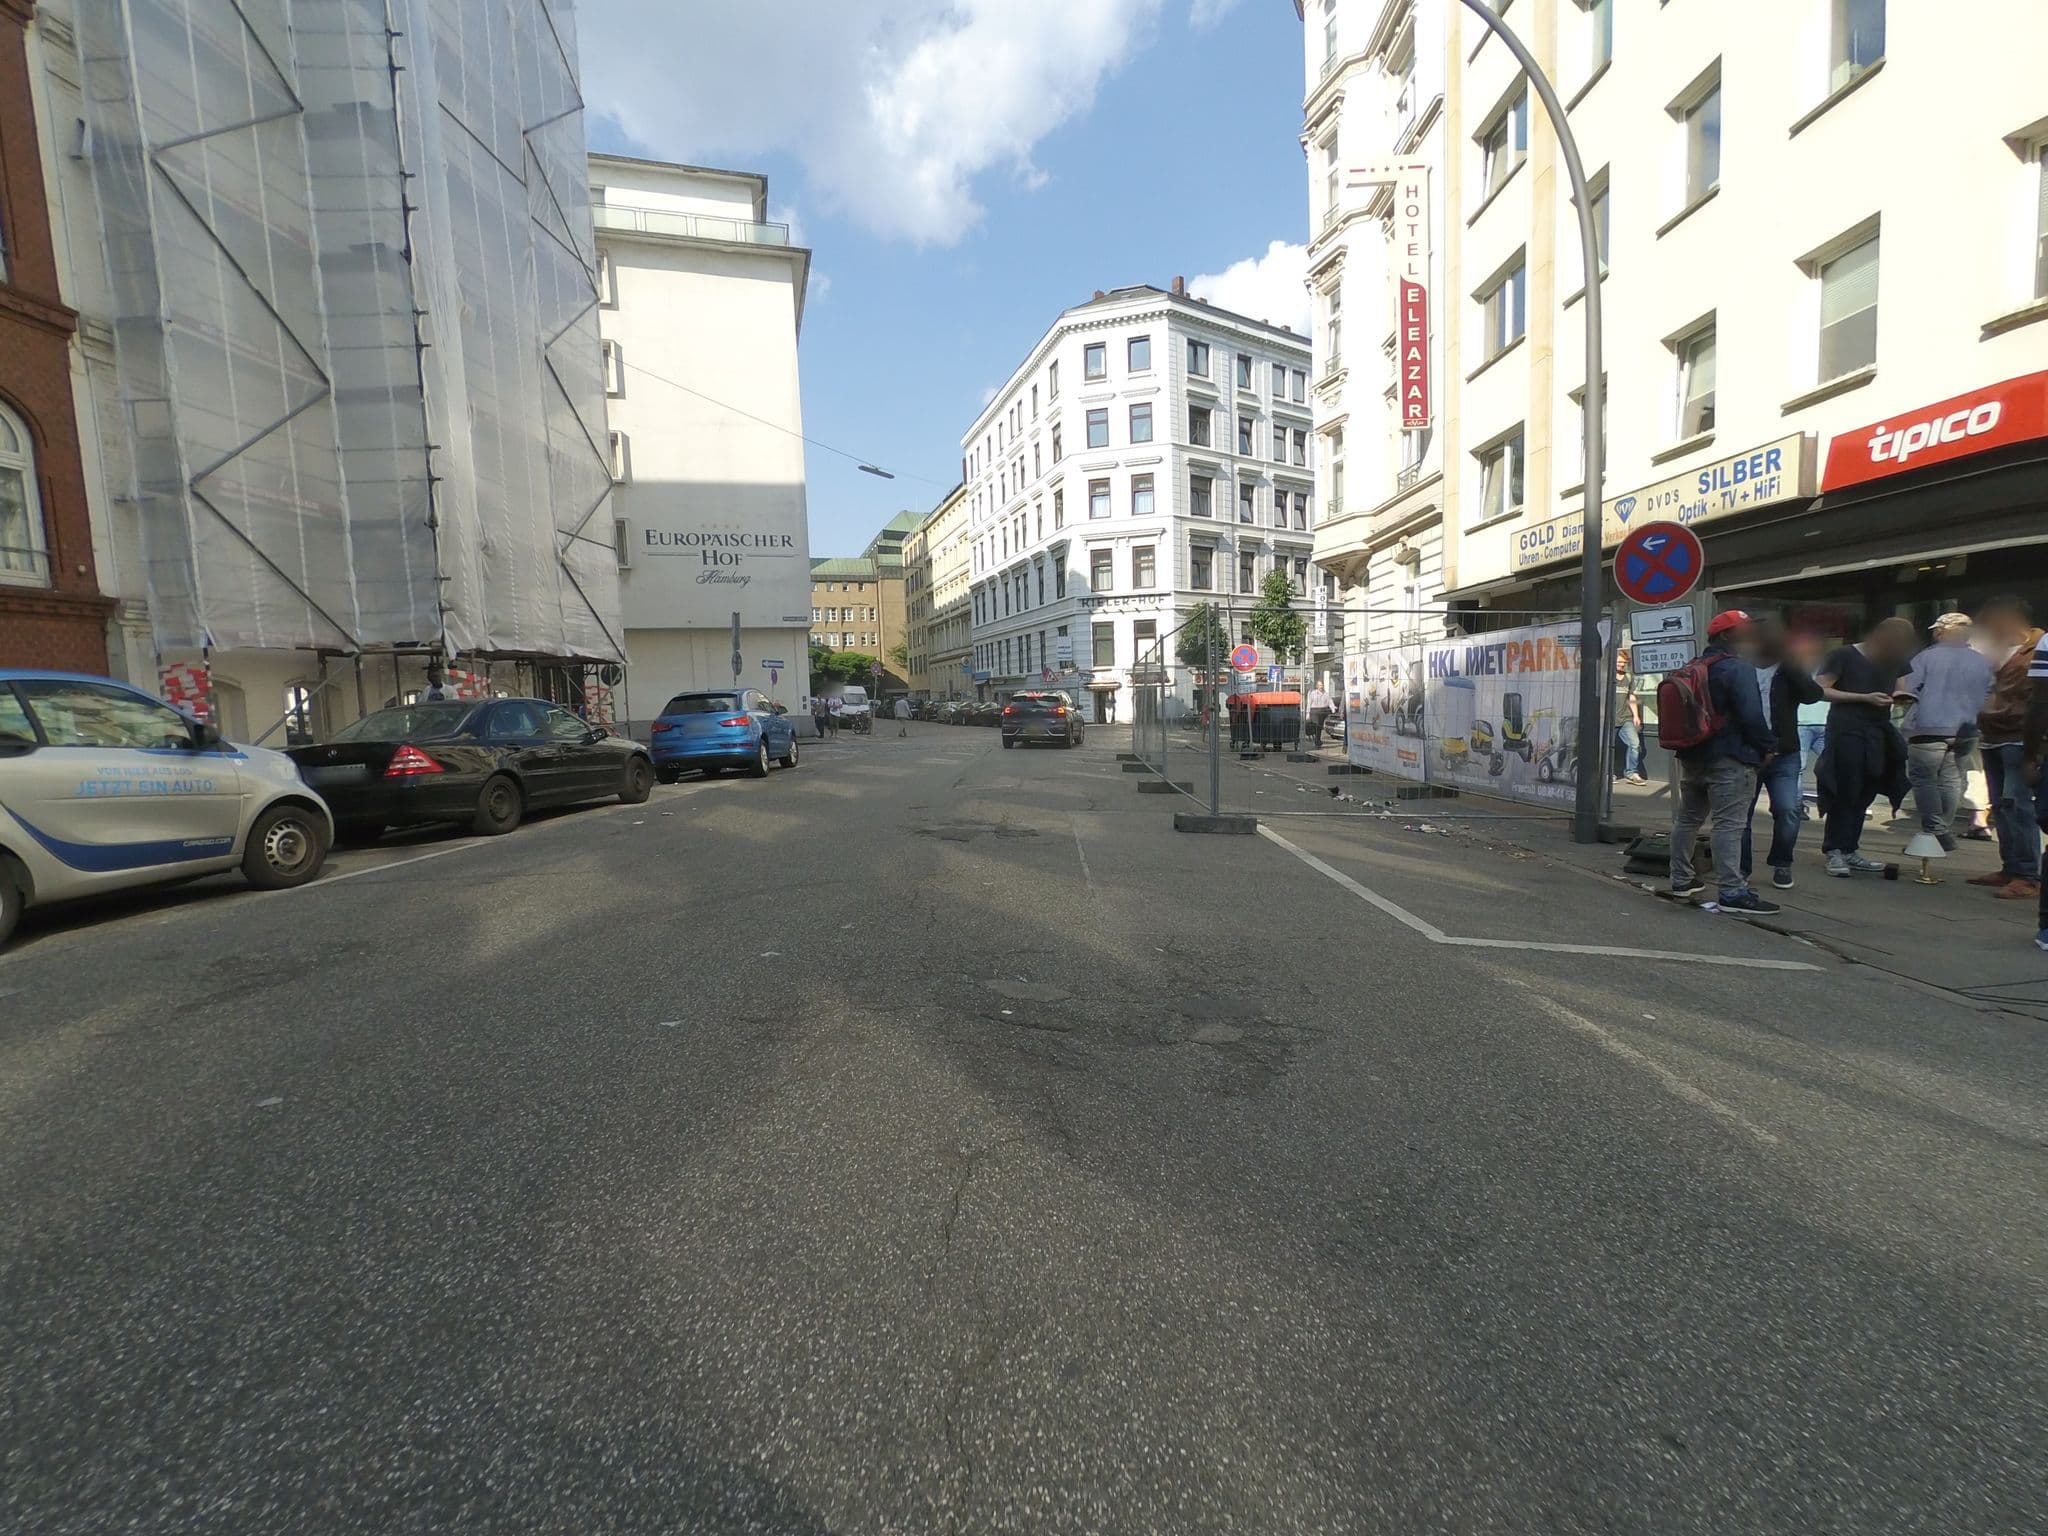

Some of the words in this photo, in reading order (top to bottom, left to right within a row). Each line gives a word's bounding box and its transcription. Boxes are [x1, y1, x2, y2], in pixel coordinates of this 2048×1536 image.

[1405, 185, 1419, 276] HOTEL
[1407, 288, 1422, 418] ELEAZAR
[1867, 401, 2001, 462] tipico
[1698, 448, 1782, 495] SILBER
[1677, 498, 1708, 526] Optik
[1720, 488, 1738, 511] TV
[1753, 475, 1781, 503] HiFi
[645, 529, 794, 548] EUROPÄISCHER
[1520, 525, 1555, 551] GOLD
[702, 550, 743, 566] HOF
[1519, 551, 1540, 566] Uhren
[1544, 539, 1581, 559] Computer
[696, 569, 751, 589] Hamburg
[1428, 649, 1460, 678] HKL
[139, 779, 168, 794] EIN
